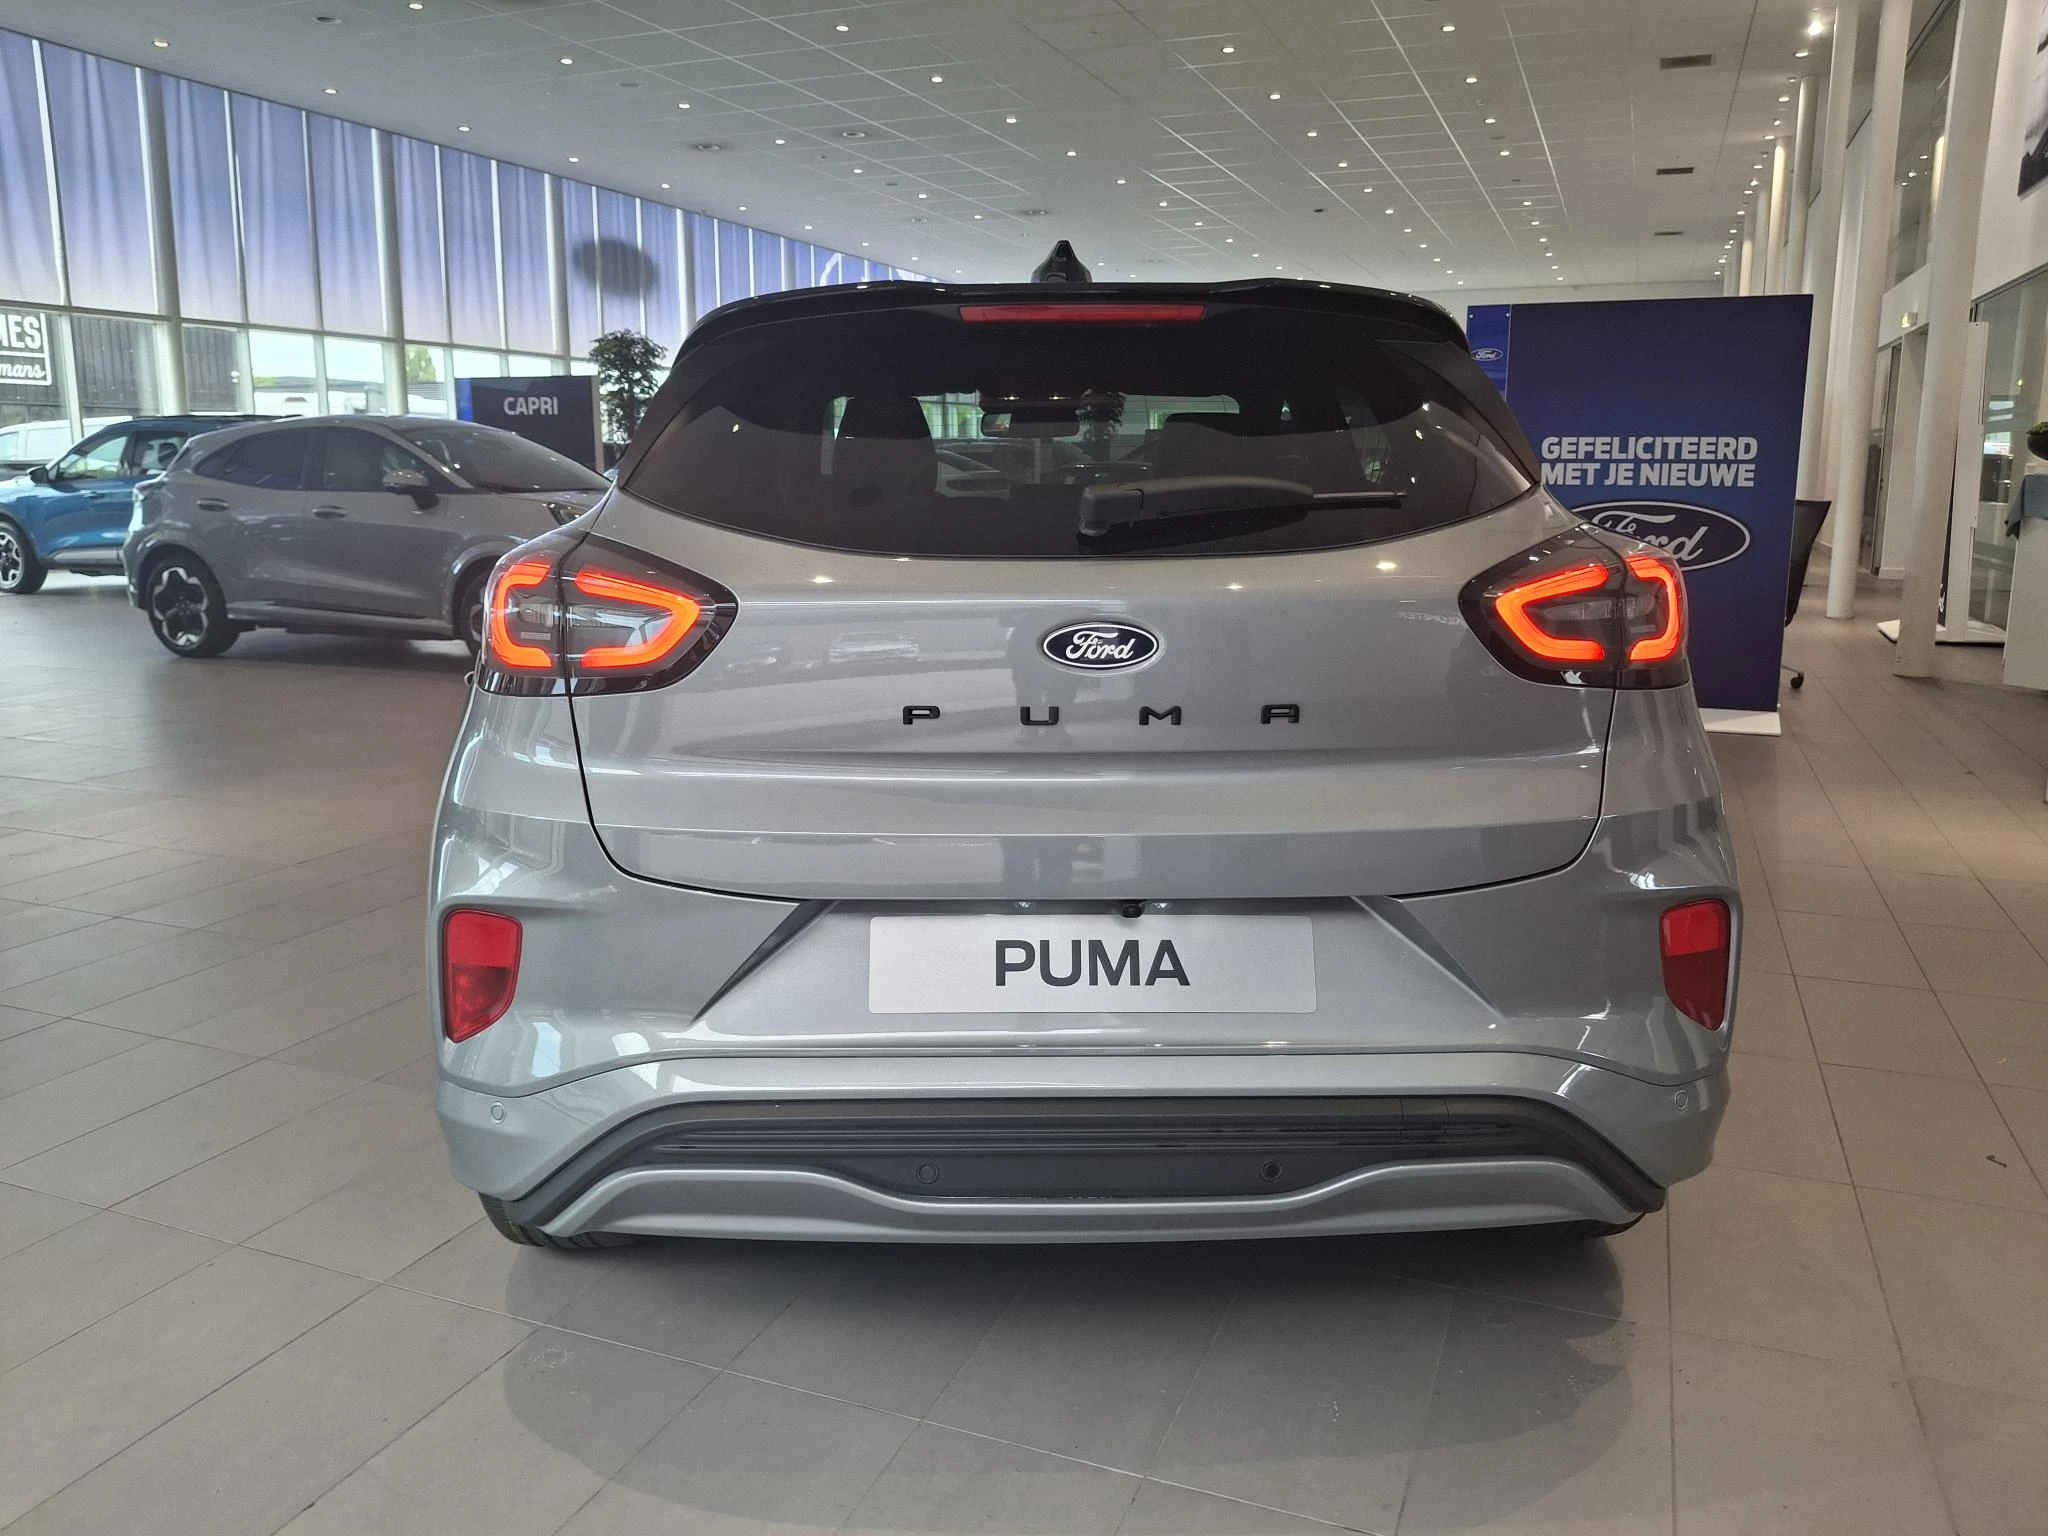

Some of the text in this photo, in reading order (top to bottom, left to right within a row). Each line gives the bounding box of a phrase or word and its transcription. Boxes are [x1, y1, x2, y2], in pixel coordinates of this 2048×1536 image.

[503, 396, 559, 416] CAPRI
[1541, 436, 1758, 460] GEFELICITEERD
[1541, 463, 1756, 487] MET JE NIEUWE
[1591, 510, 1709, 561] Frd
[1065, 630, 1136, 659] Ford
[902, 704, 1302, 727] PUMA
[995, 939, 1191, 986] PUMA
